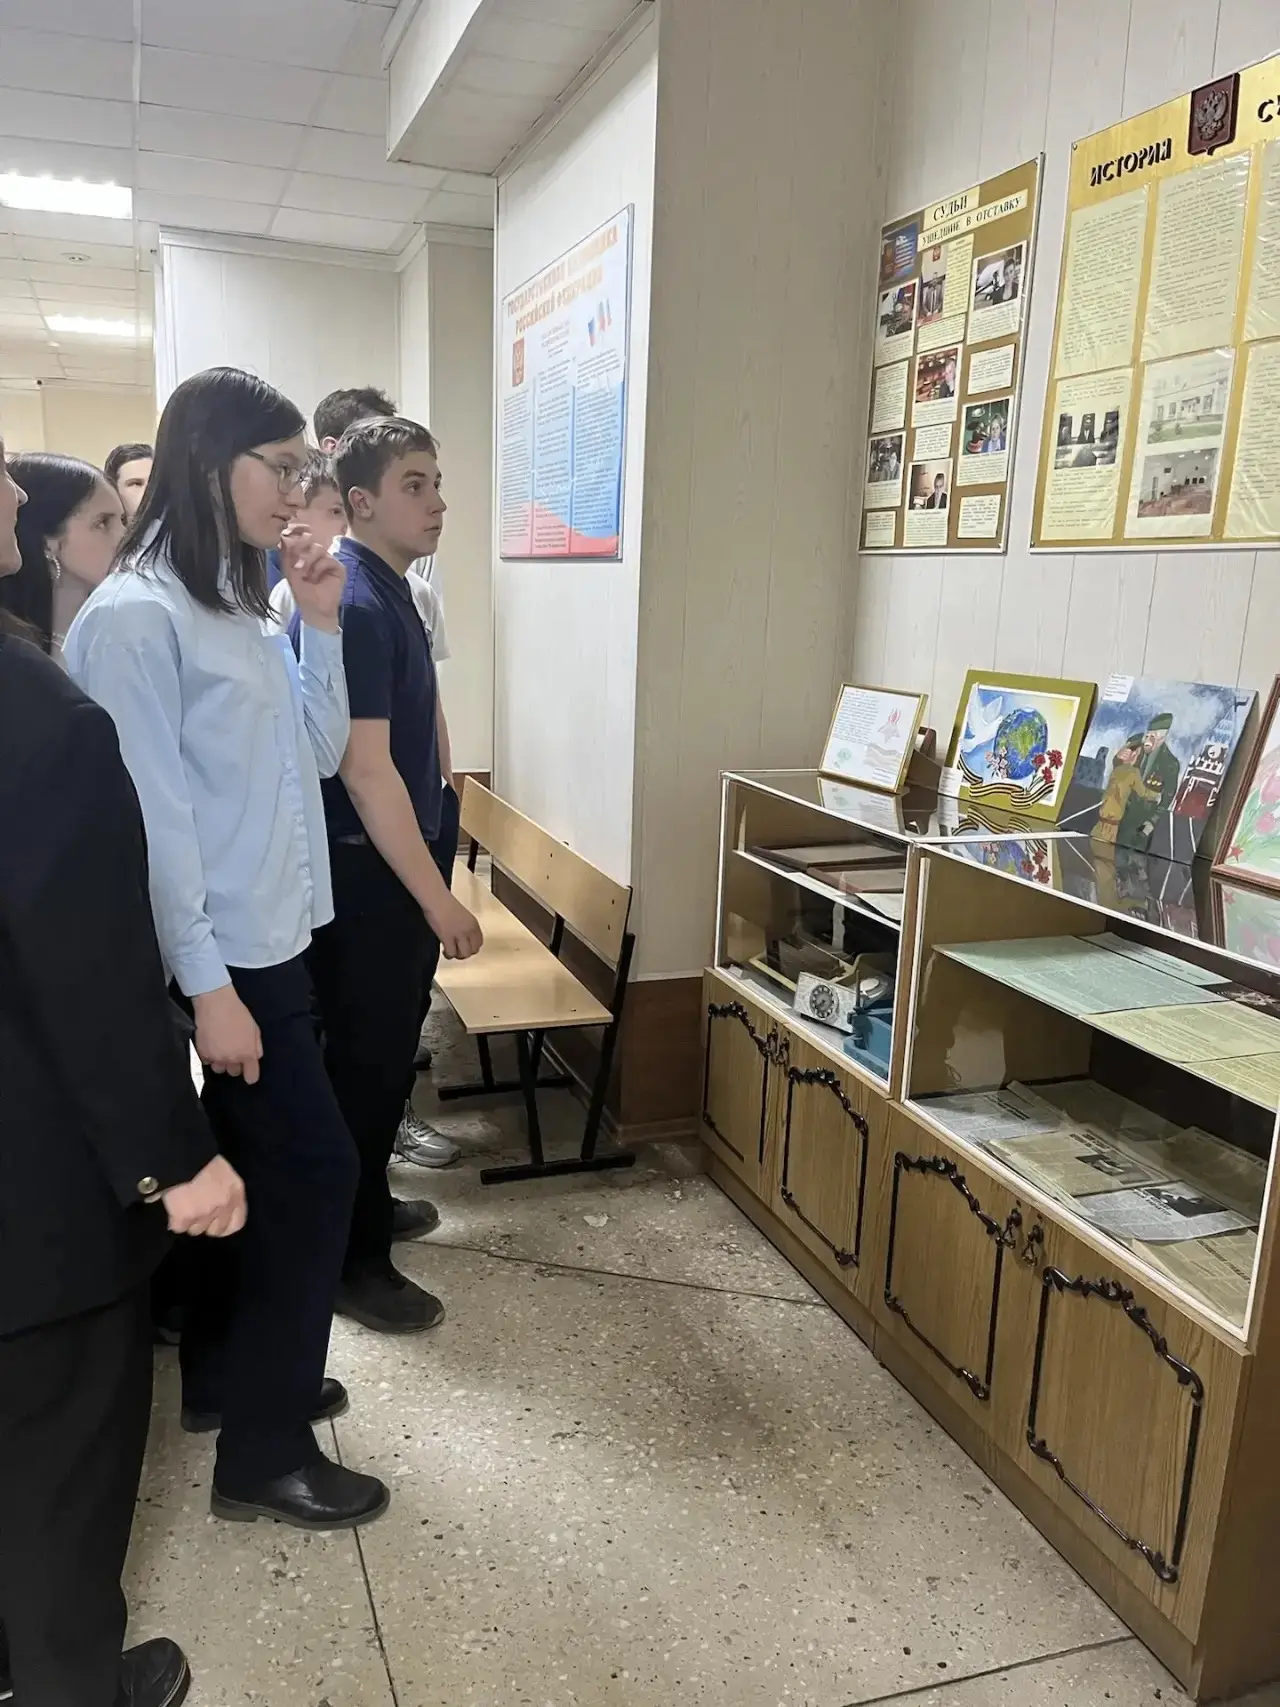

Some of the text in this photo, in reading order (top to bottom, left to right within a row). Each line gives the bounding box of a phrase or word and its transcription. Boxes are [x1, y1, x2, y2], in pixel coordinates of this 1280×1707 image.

[1090, 95, 1280, 187] ИСТОРИЯ С
[922, 197, 1022, 246] УШЕДШИЕ В ОТСТАВКУ
[933, 195, 968, 222] СУДЬИ
